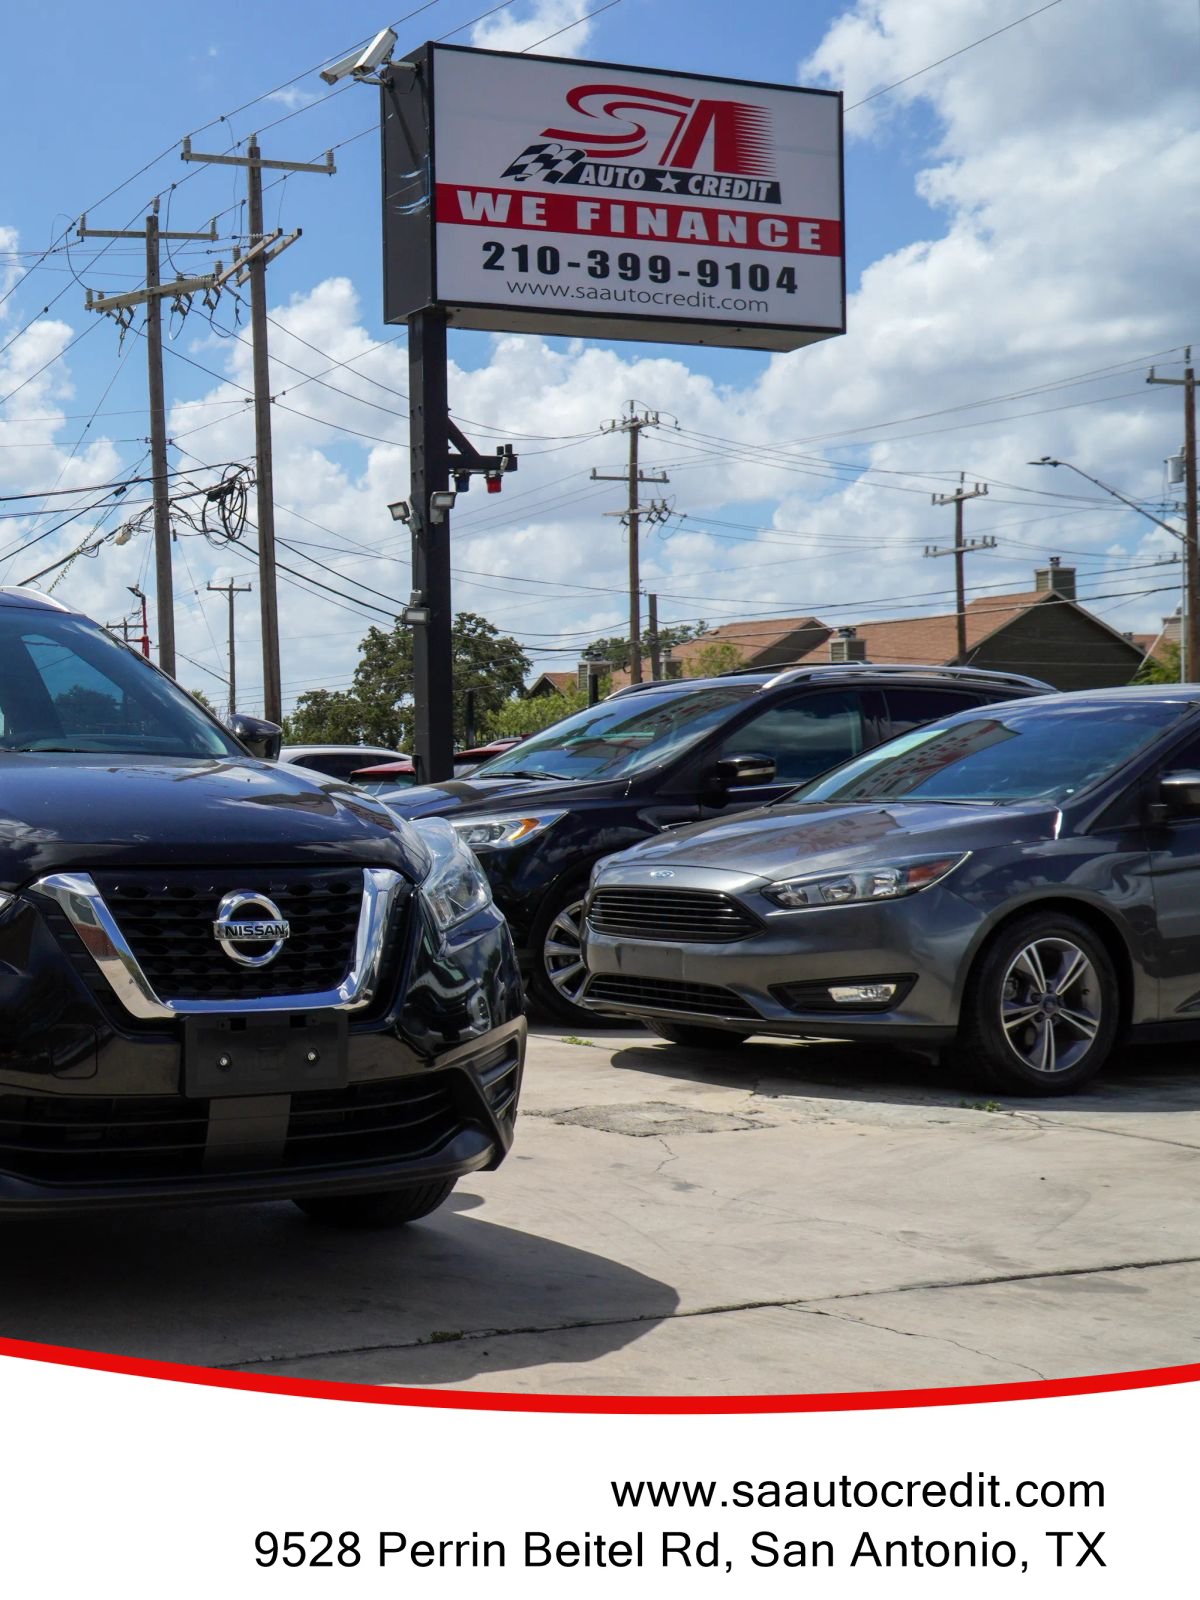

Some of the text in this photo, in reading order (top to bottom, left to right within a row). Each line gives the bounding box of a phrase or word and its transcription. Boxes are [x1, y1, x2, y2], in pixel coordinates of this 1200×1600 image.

[578, 163, 773, 202] AUTO CREDIT
[456, 189, 822, 251] WE FINANCE
[482, 240, 799, 295] 210-399-9104
[506, 280, 769, 313] www.saautocredit.com
[224, 924, 286, 937] NISSAN
